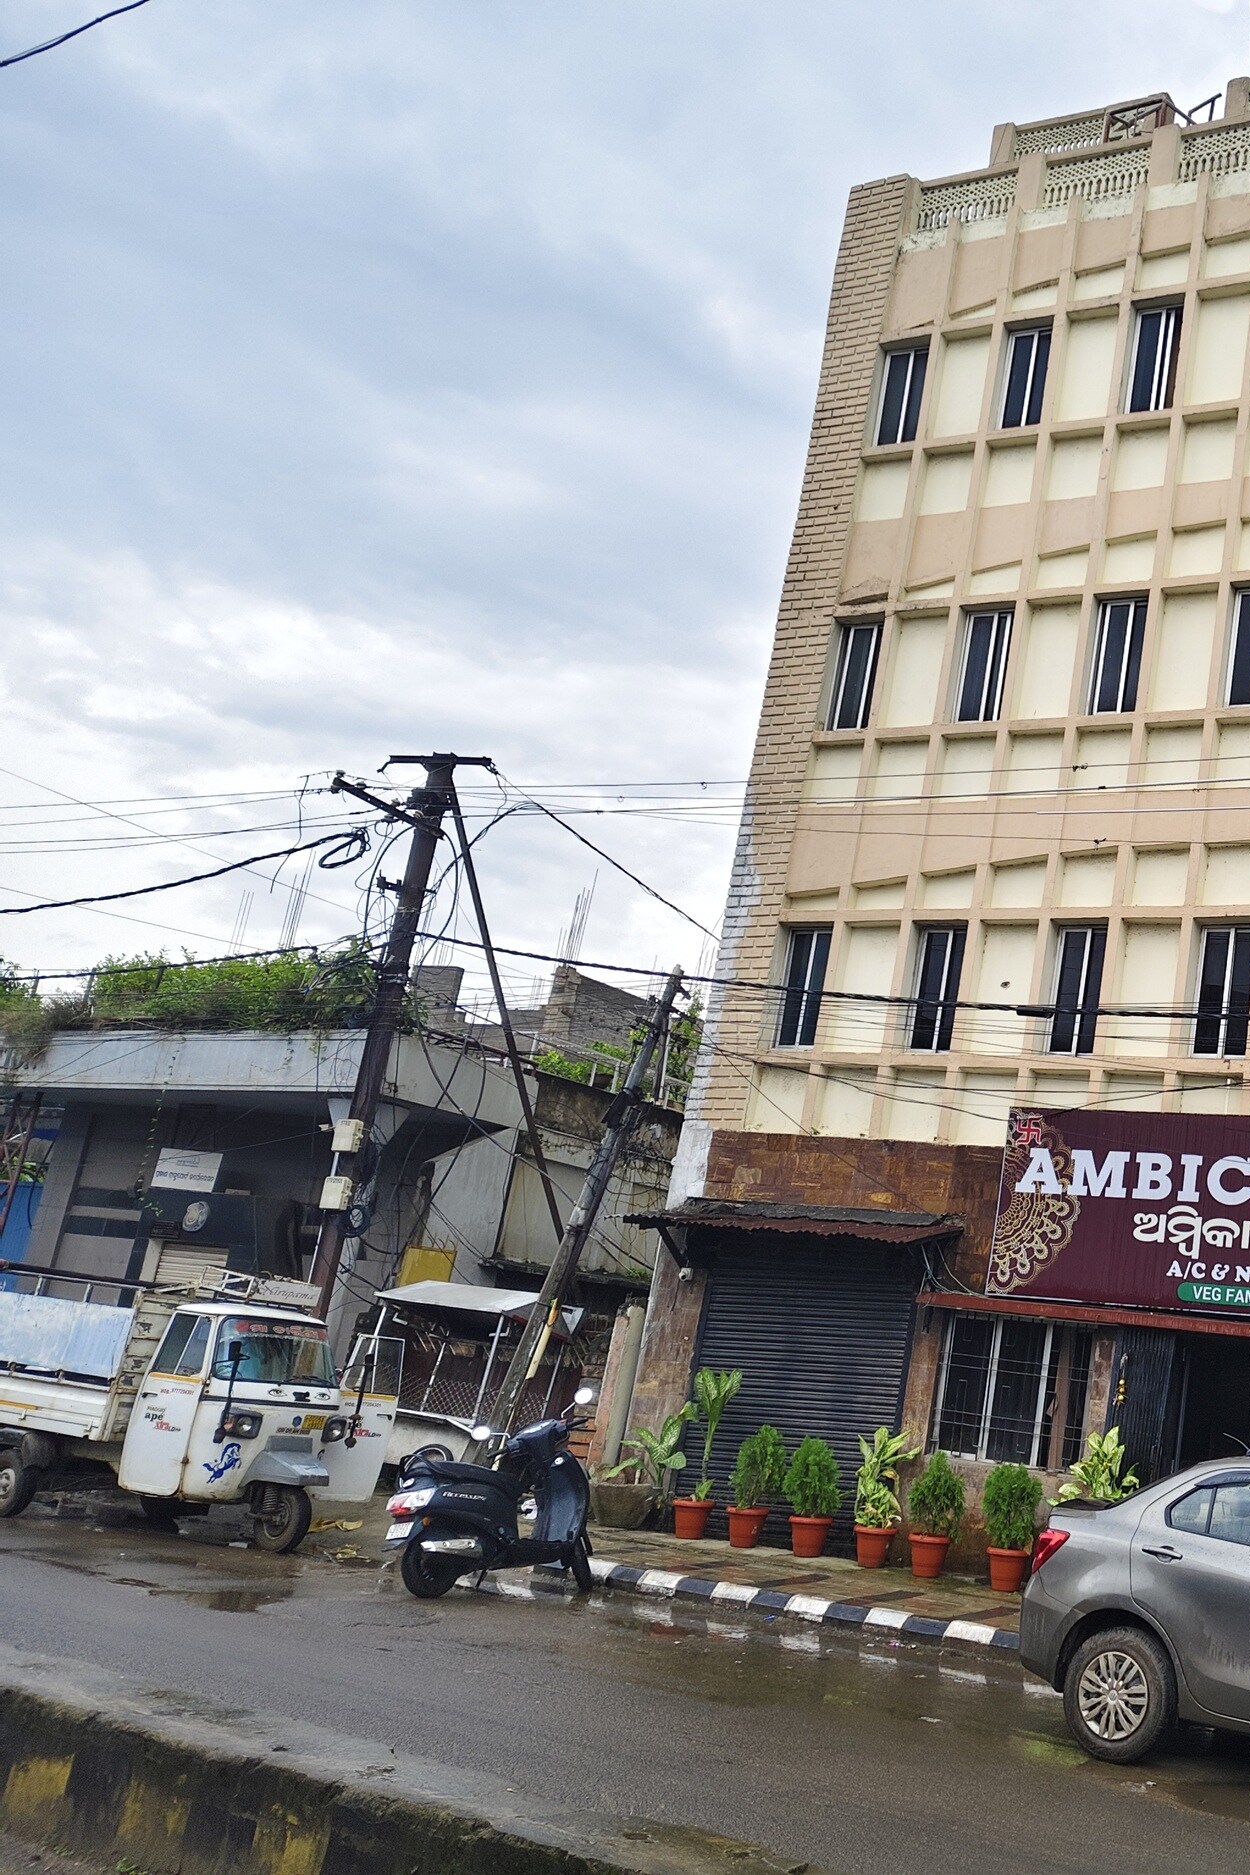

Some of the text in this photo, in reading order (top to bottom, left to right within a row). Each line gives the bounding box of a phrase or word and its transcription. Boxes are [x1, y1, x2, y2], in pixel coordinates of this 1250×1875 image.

[1132, 1205, 1250, 1259] ଅମ୍ବିକା
[1166, 1260, 1206, 1280] A/C
[1211, 1263, 1230, 1281] &
[1192, 1285, 1222, 1301] VEG
